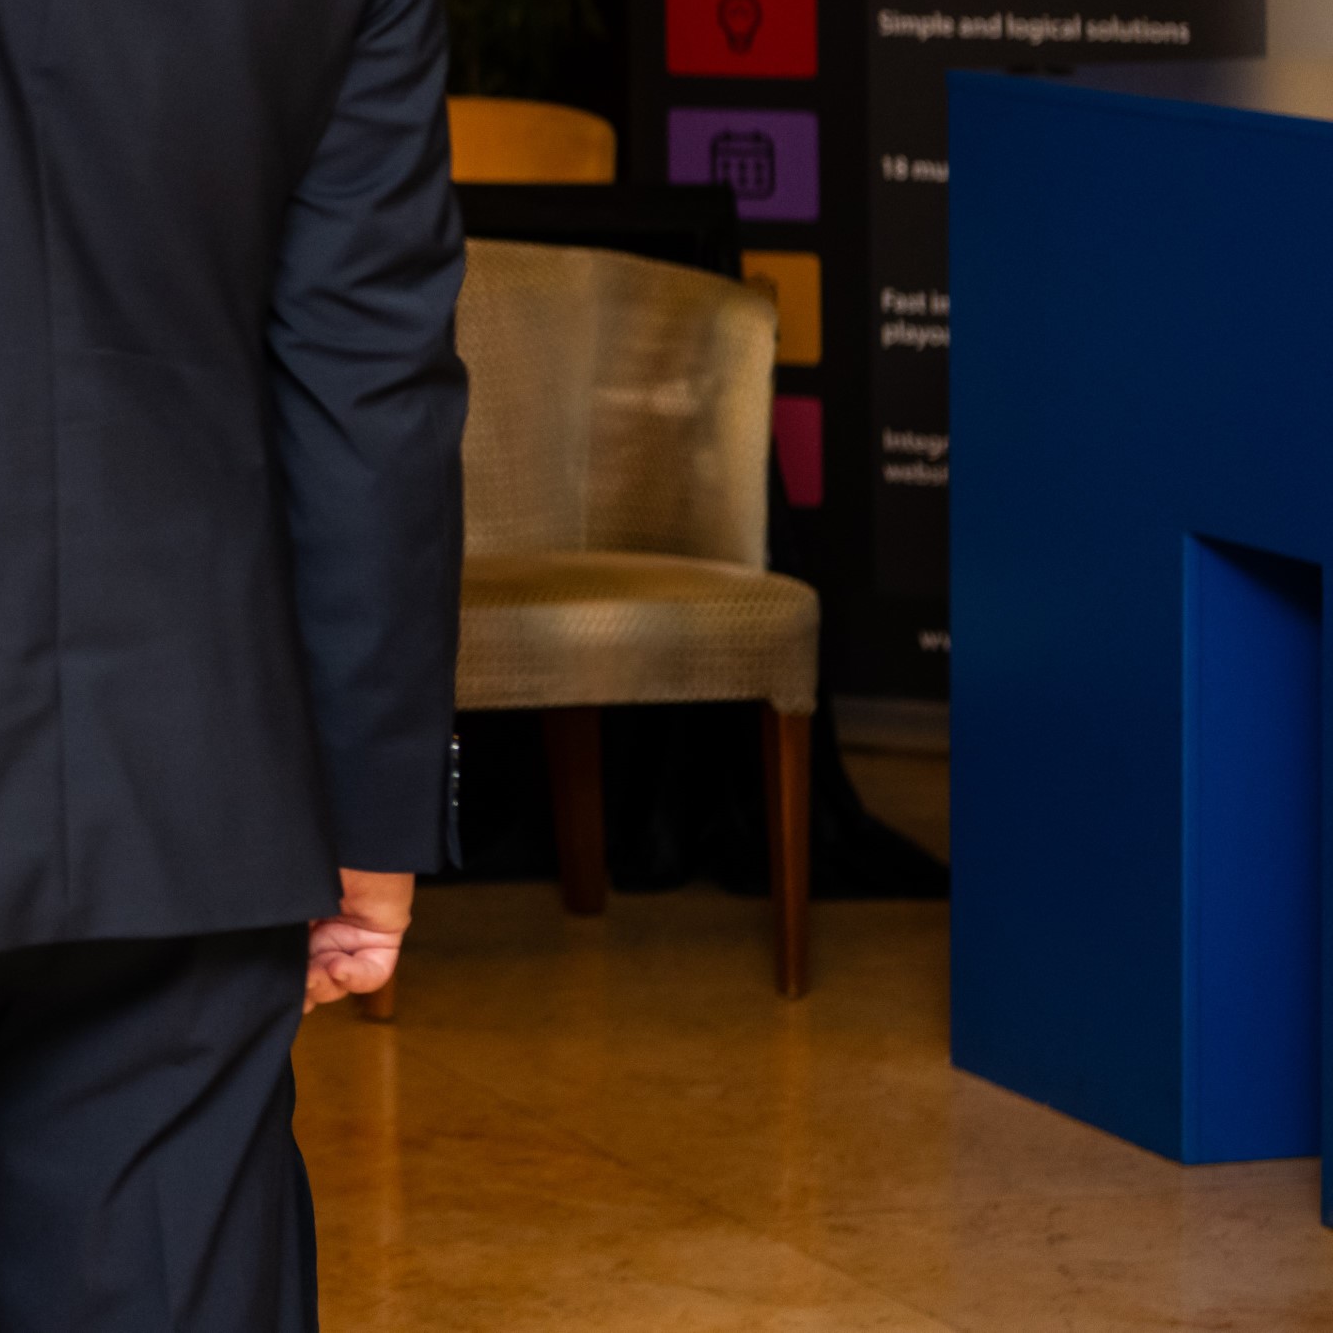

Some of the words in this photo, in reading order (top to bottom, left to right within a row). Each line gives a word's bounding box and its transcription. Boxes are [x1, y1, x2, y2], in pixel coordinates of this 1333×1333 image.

[878, 8, 955, 43] Simple
[958, 12, 1002, 39] and
[1005, 12, 1082, 46] logical
[1084, 14, 1190, 45] solutions
[882, 154, 909, 182] 18
[881, 287, 926, 315] Fast
